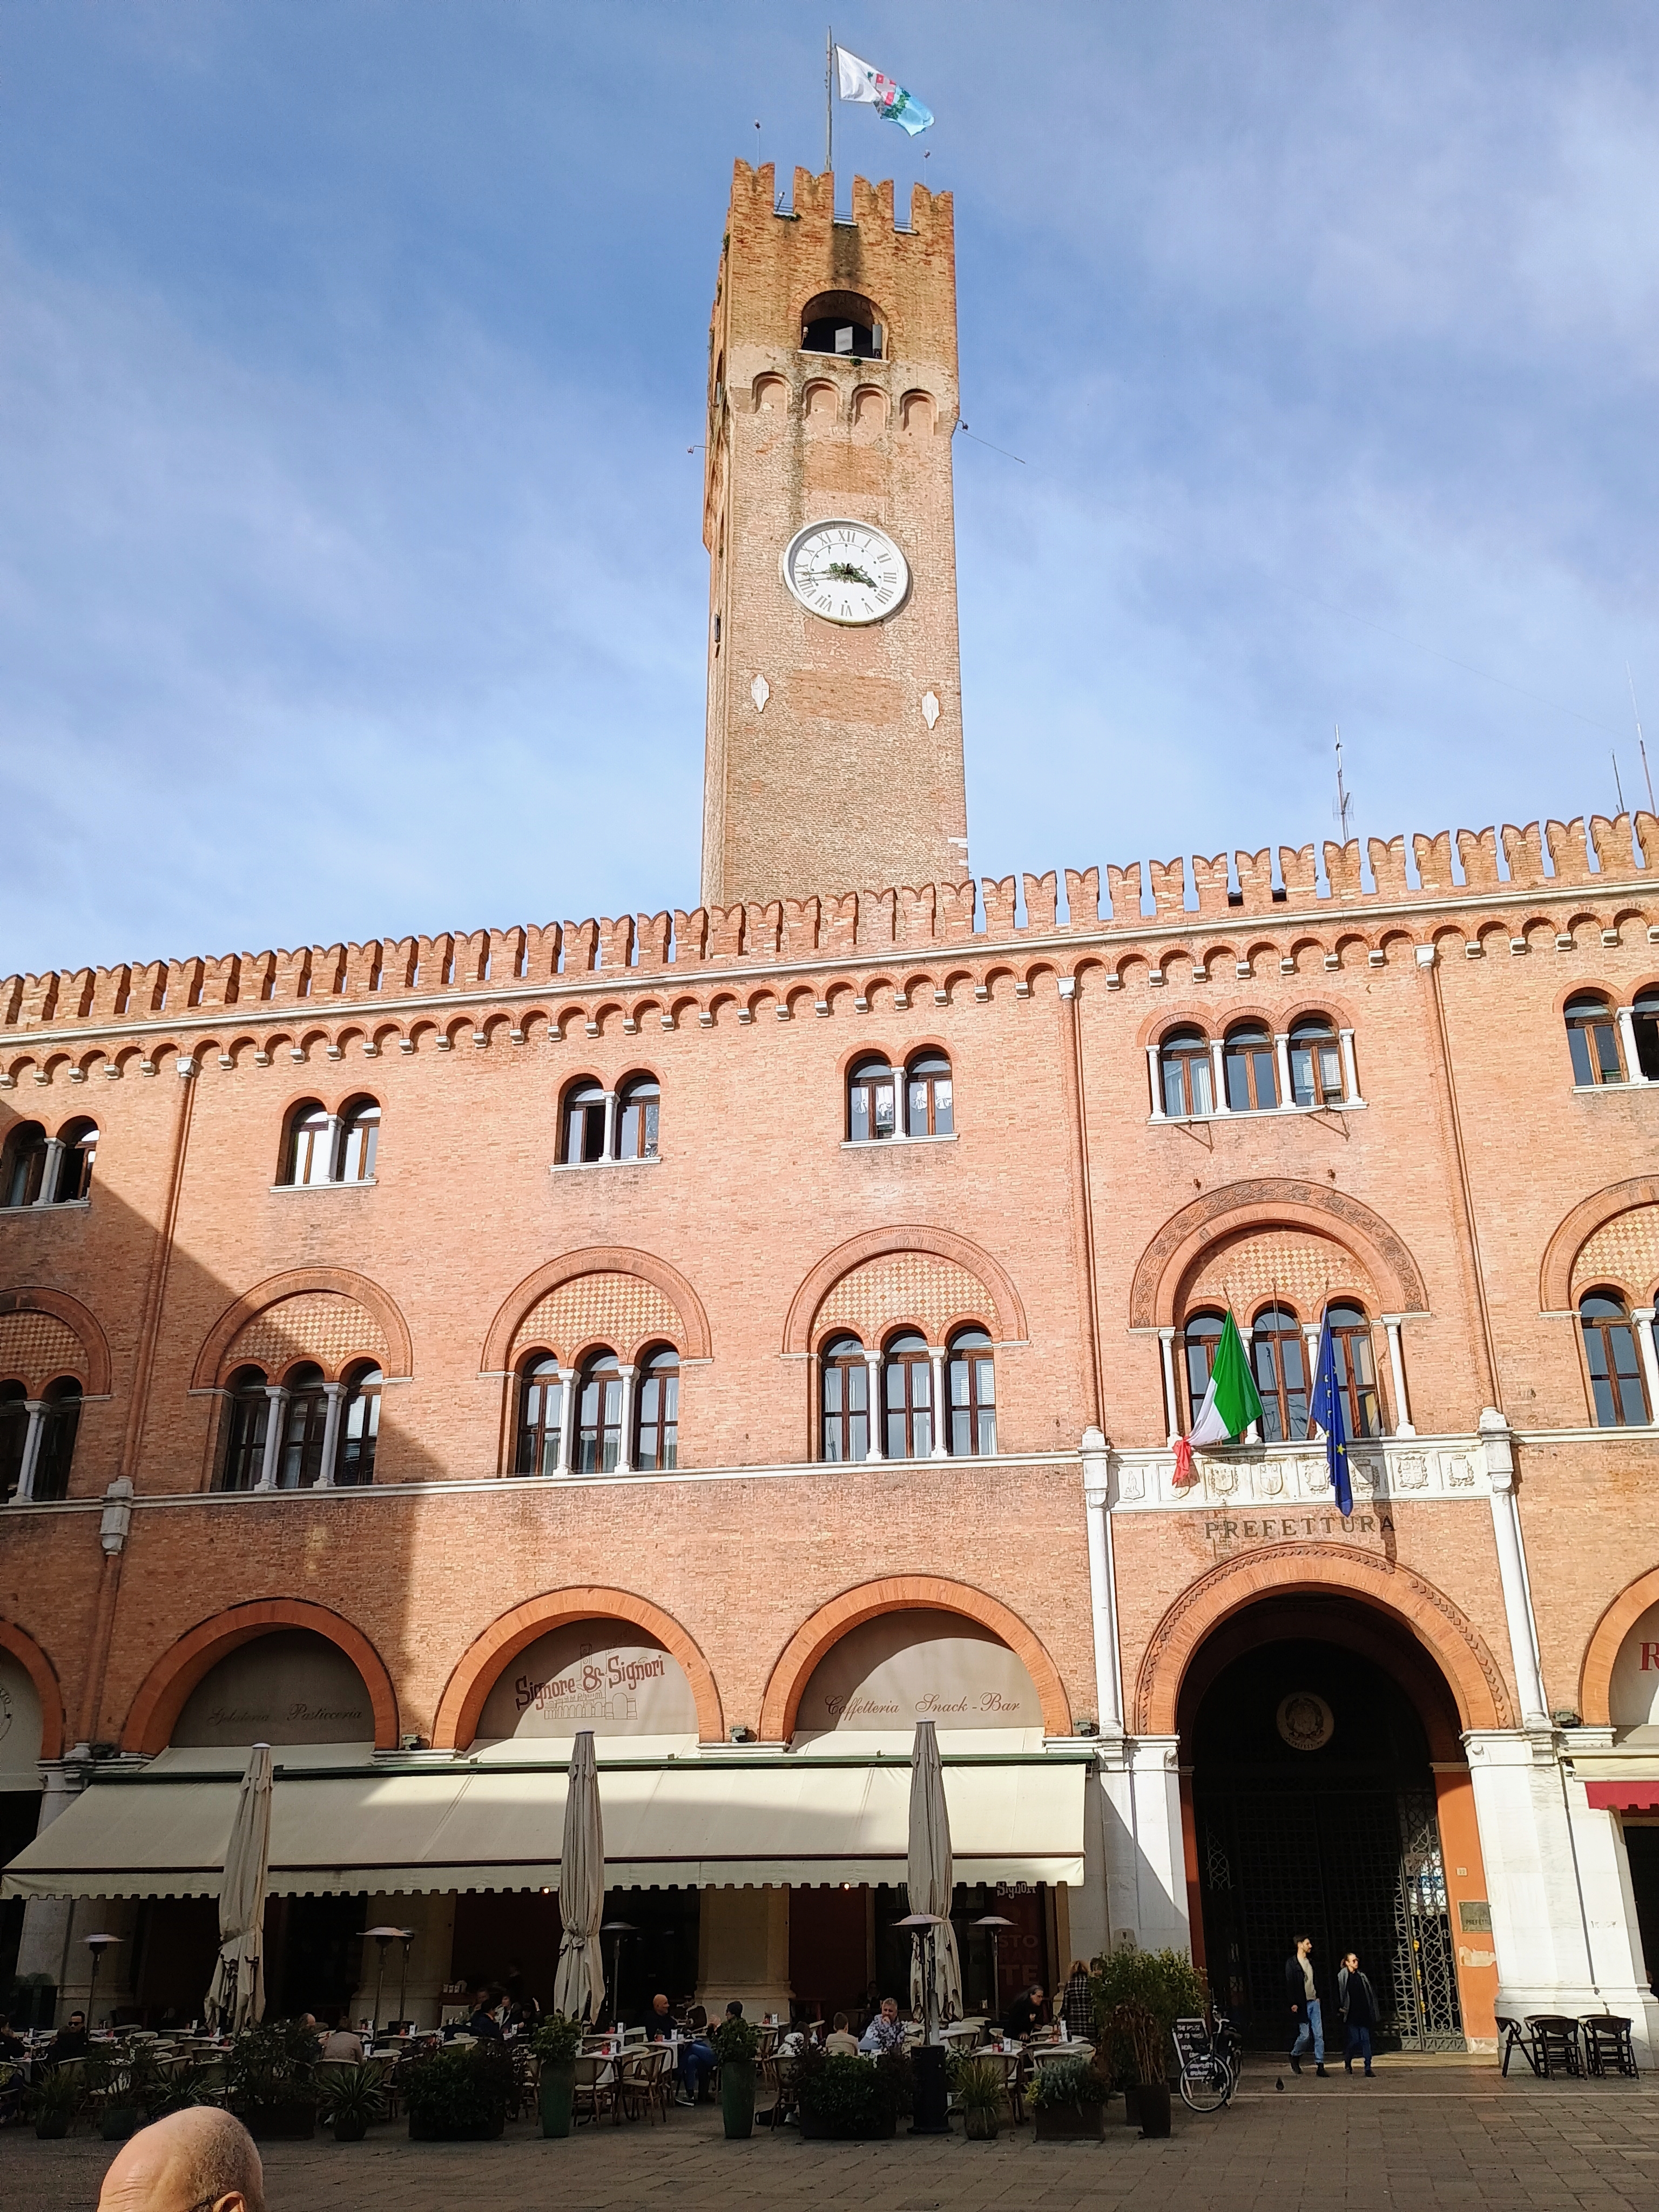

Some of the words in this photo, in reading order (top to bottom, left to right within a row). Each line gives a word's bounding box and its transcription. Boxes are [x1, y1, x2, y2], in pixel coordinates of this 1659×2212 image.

[817, 532, 832, 546] XI
[838, 530, 855, 543] XII
[801, 545, 815, 556] X
[877, 553, 891, 563] II
[884, 572, 896, 584] III
[798, 580, 817, 598] VIII
[875, 588, 894, 605] IIII
[815, 595, 832, 612] VII
[841, 604, 853, 616] VI
[864, 602, 874, 614] V
[1205, 1515, 1397, 1539] PREFETTURA
[515, 1675, 576, 1711] Signore
[583, 1665, 604, 1693] &
[608, 1655, 665, 1690] Signori
[287, 1703, 362, 1721] Pasticceria
[825, 1695, 900, 1721] Caffetteria
